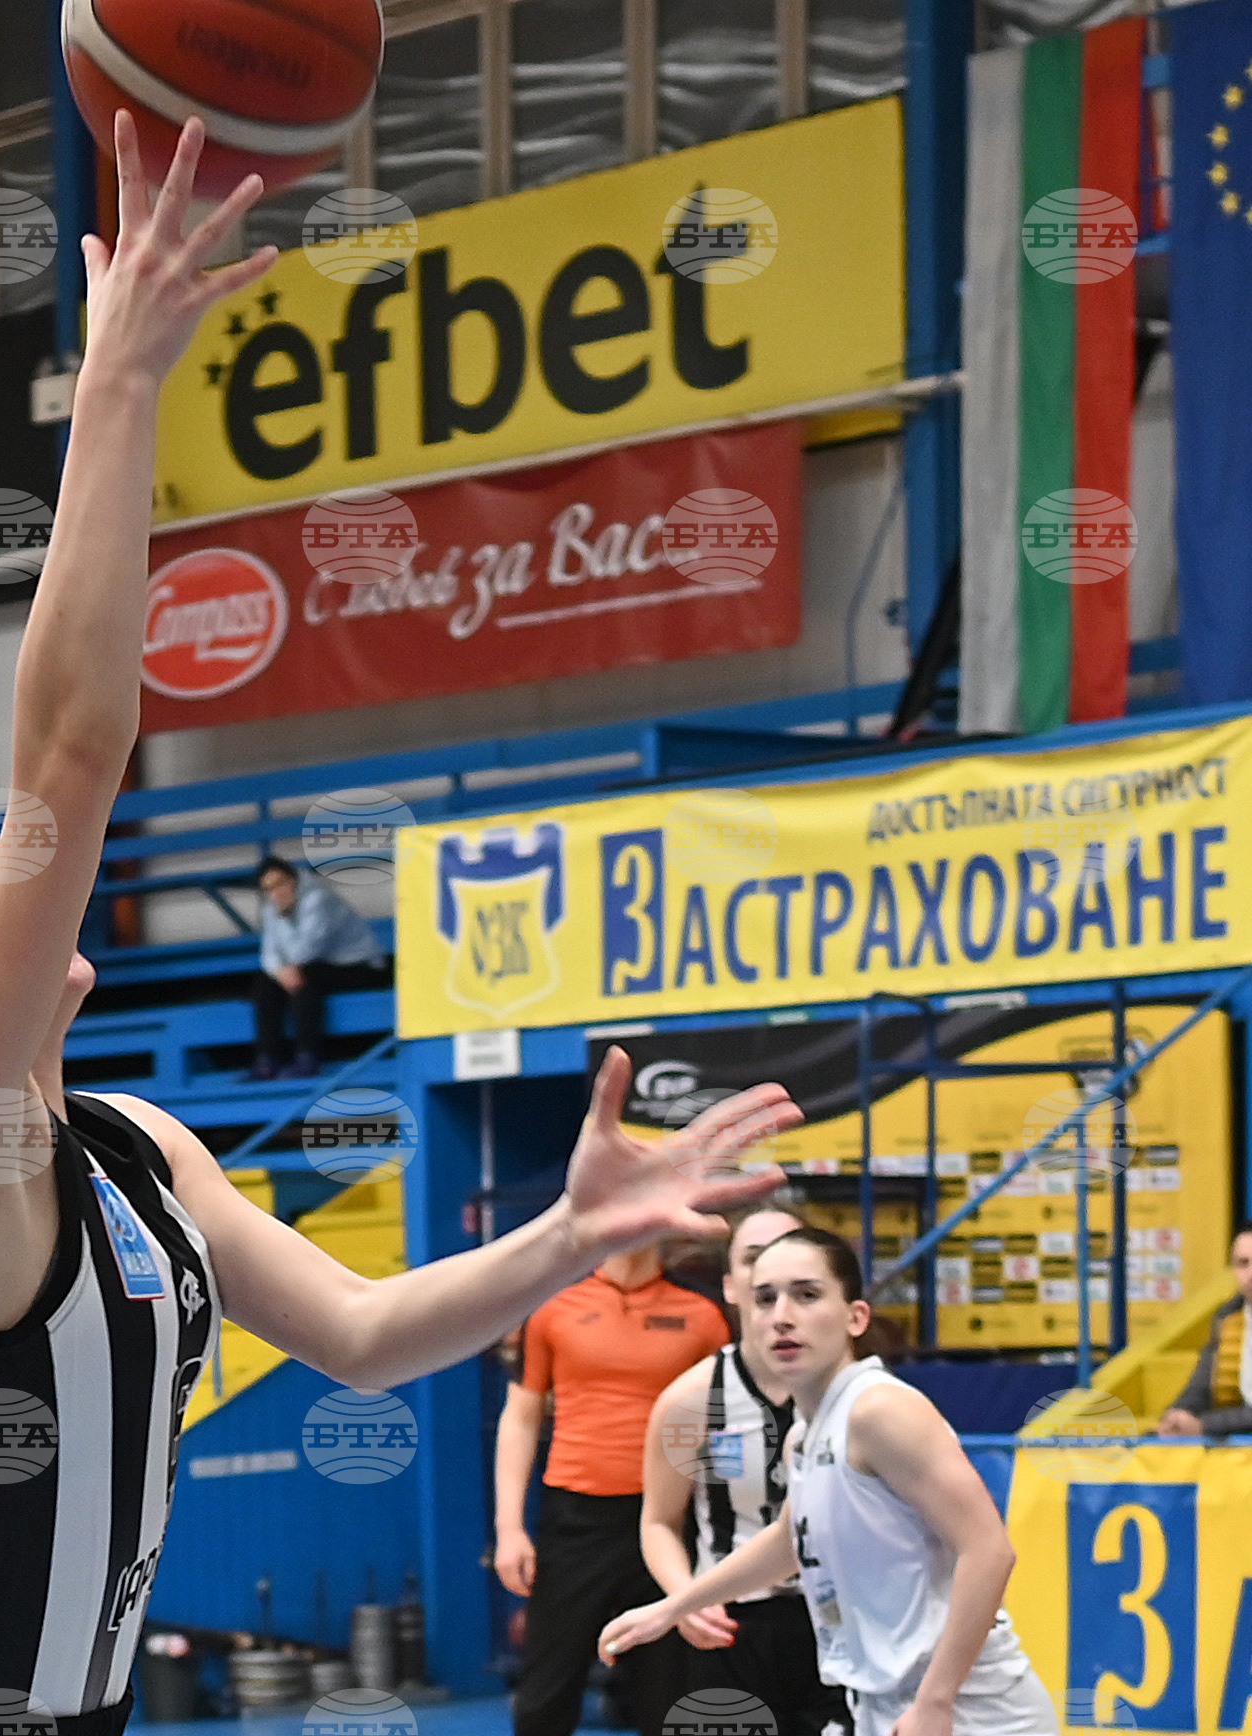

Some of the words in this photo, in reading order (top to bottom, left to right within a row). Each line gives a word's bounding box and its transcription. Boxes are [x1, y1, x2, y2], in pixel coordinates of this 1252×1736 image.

[223, 182, 751, 482] efbet
[450, 541, 536, 640] за
[604, 826, 1230, 997] ЗАСТРАХОВАНЕ
